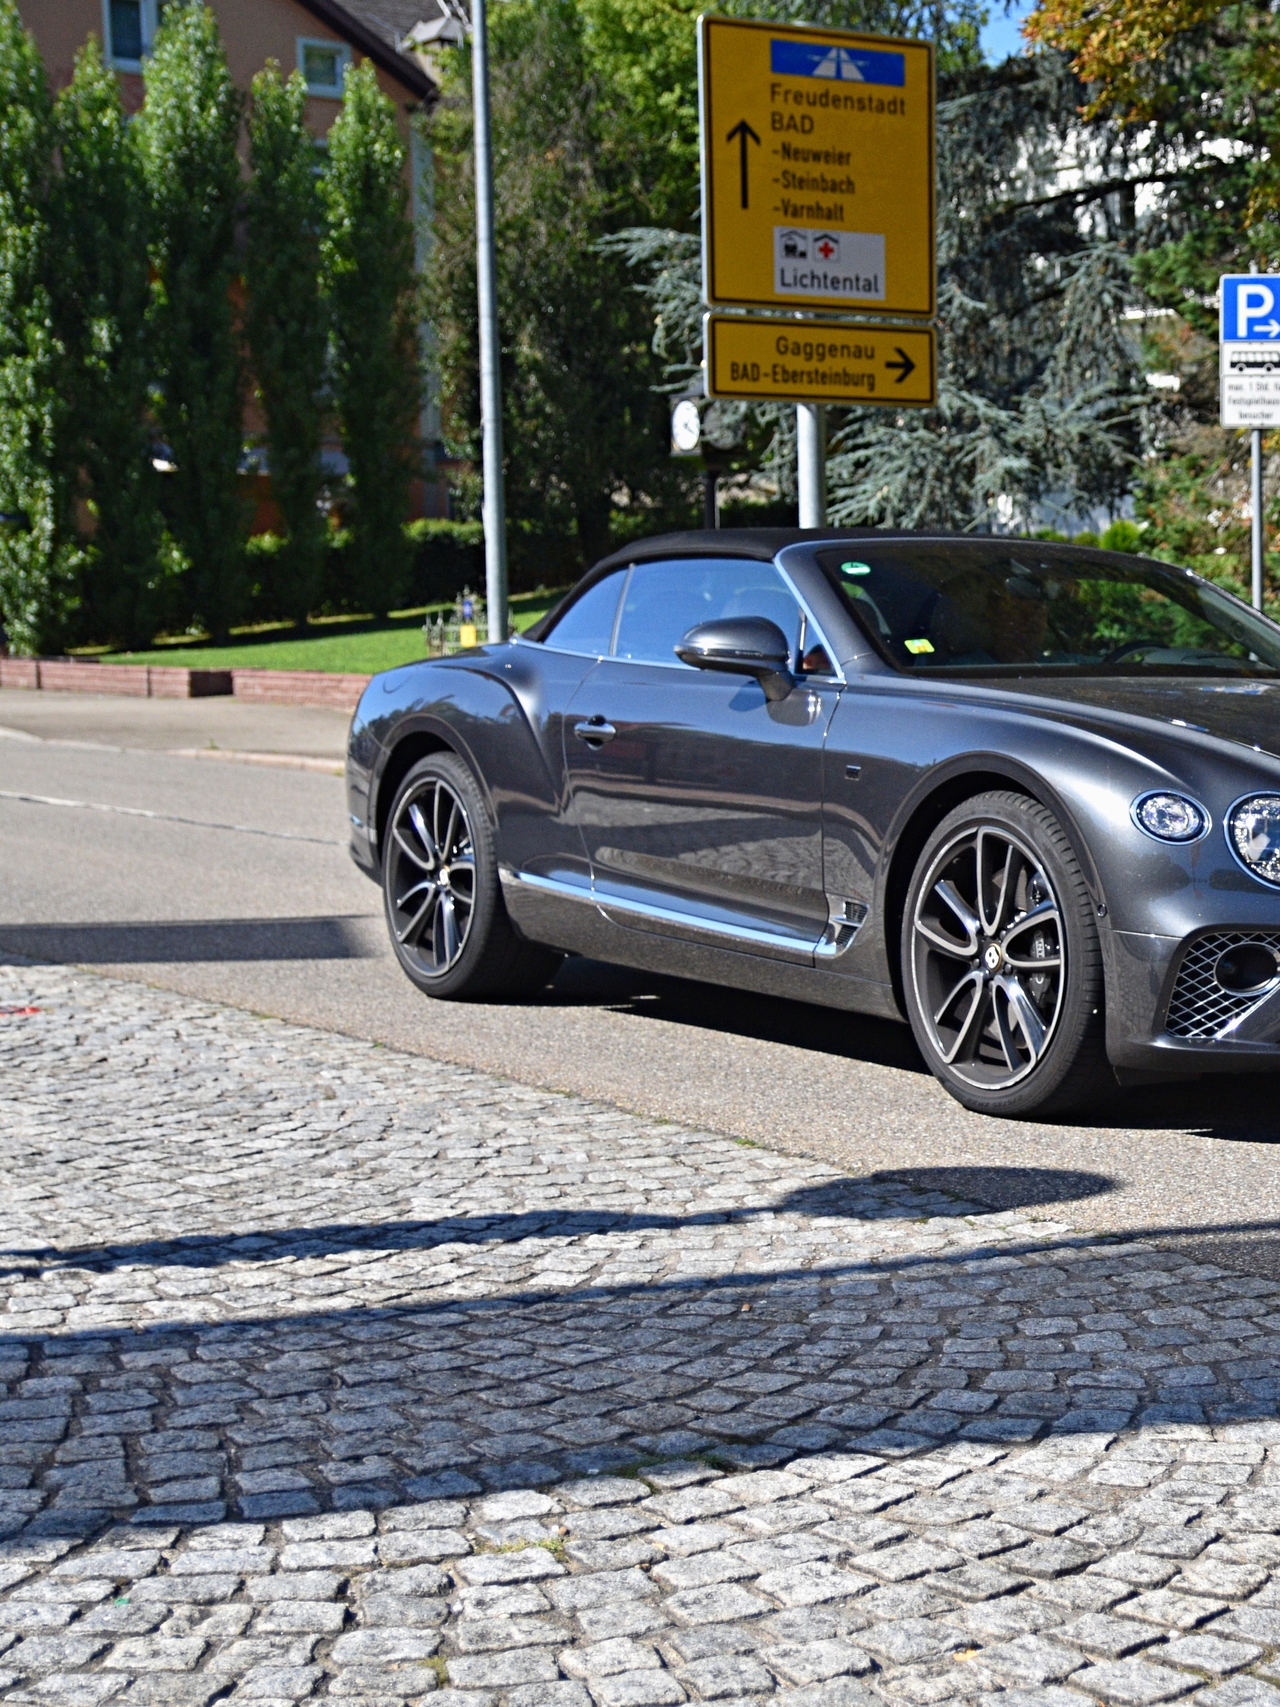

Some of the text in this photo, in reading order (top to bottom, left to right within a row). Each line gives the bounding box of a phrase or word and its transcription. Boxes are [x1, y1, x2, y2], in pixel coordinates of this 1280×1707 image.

[770, 83, 905, 115] Freudenstadt
[771, 111, 814, 134] BAD
[780, 267, 879, 293] Lichtental
[1237, 284, 1274, 338] P
[776, 336, 875, 362] Gaggenau
